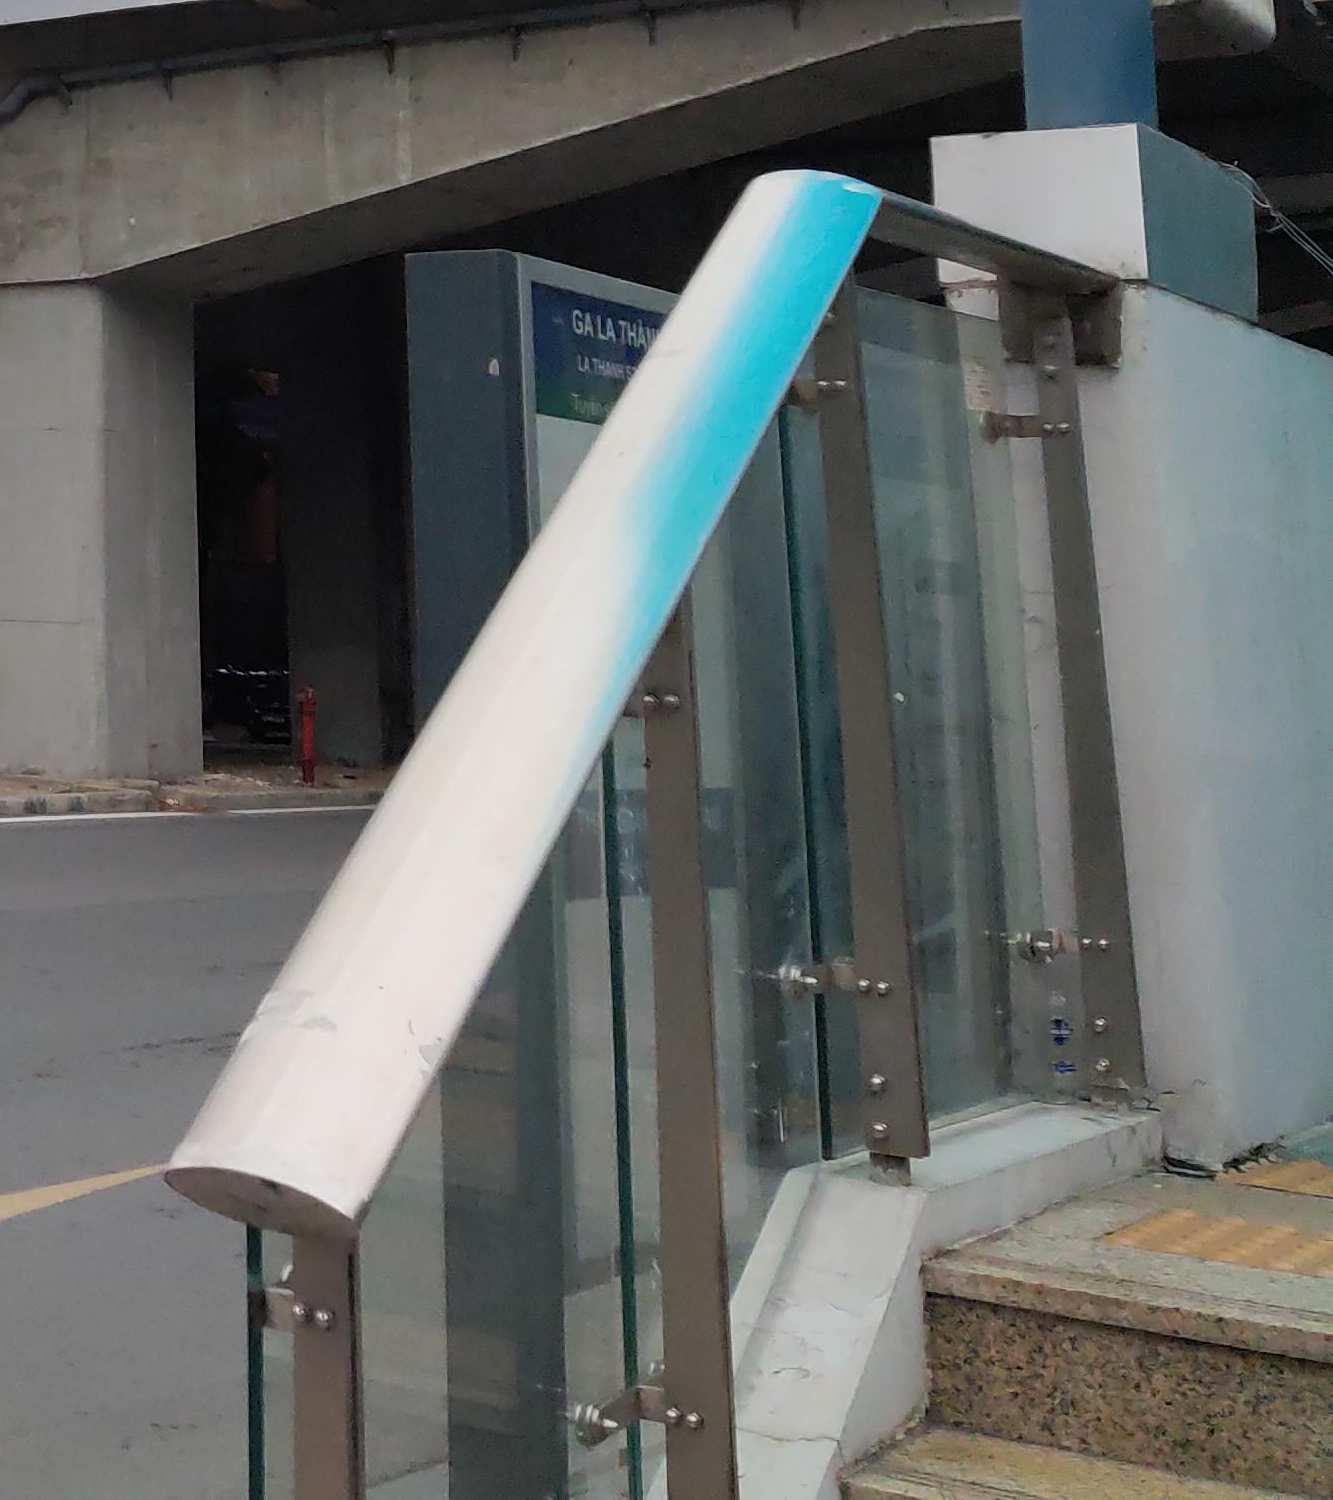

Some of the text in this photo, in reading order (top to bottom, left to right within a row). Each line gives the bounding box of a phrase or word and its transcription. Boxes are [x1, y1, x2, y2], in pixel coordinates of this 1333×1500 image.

[572, 309, 594, 338] GA
[596, 315, 617, 343] LA
[577, 354, 591, 373] LA
